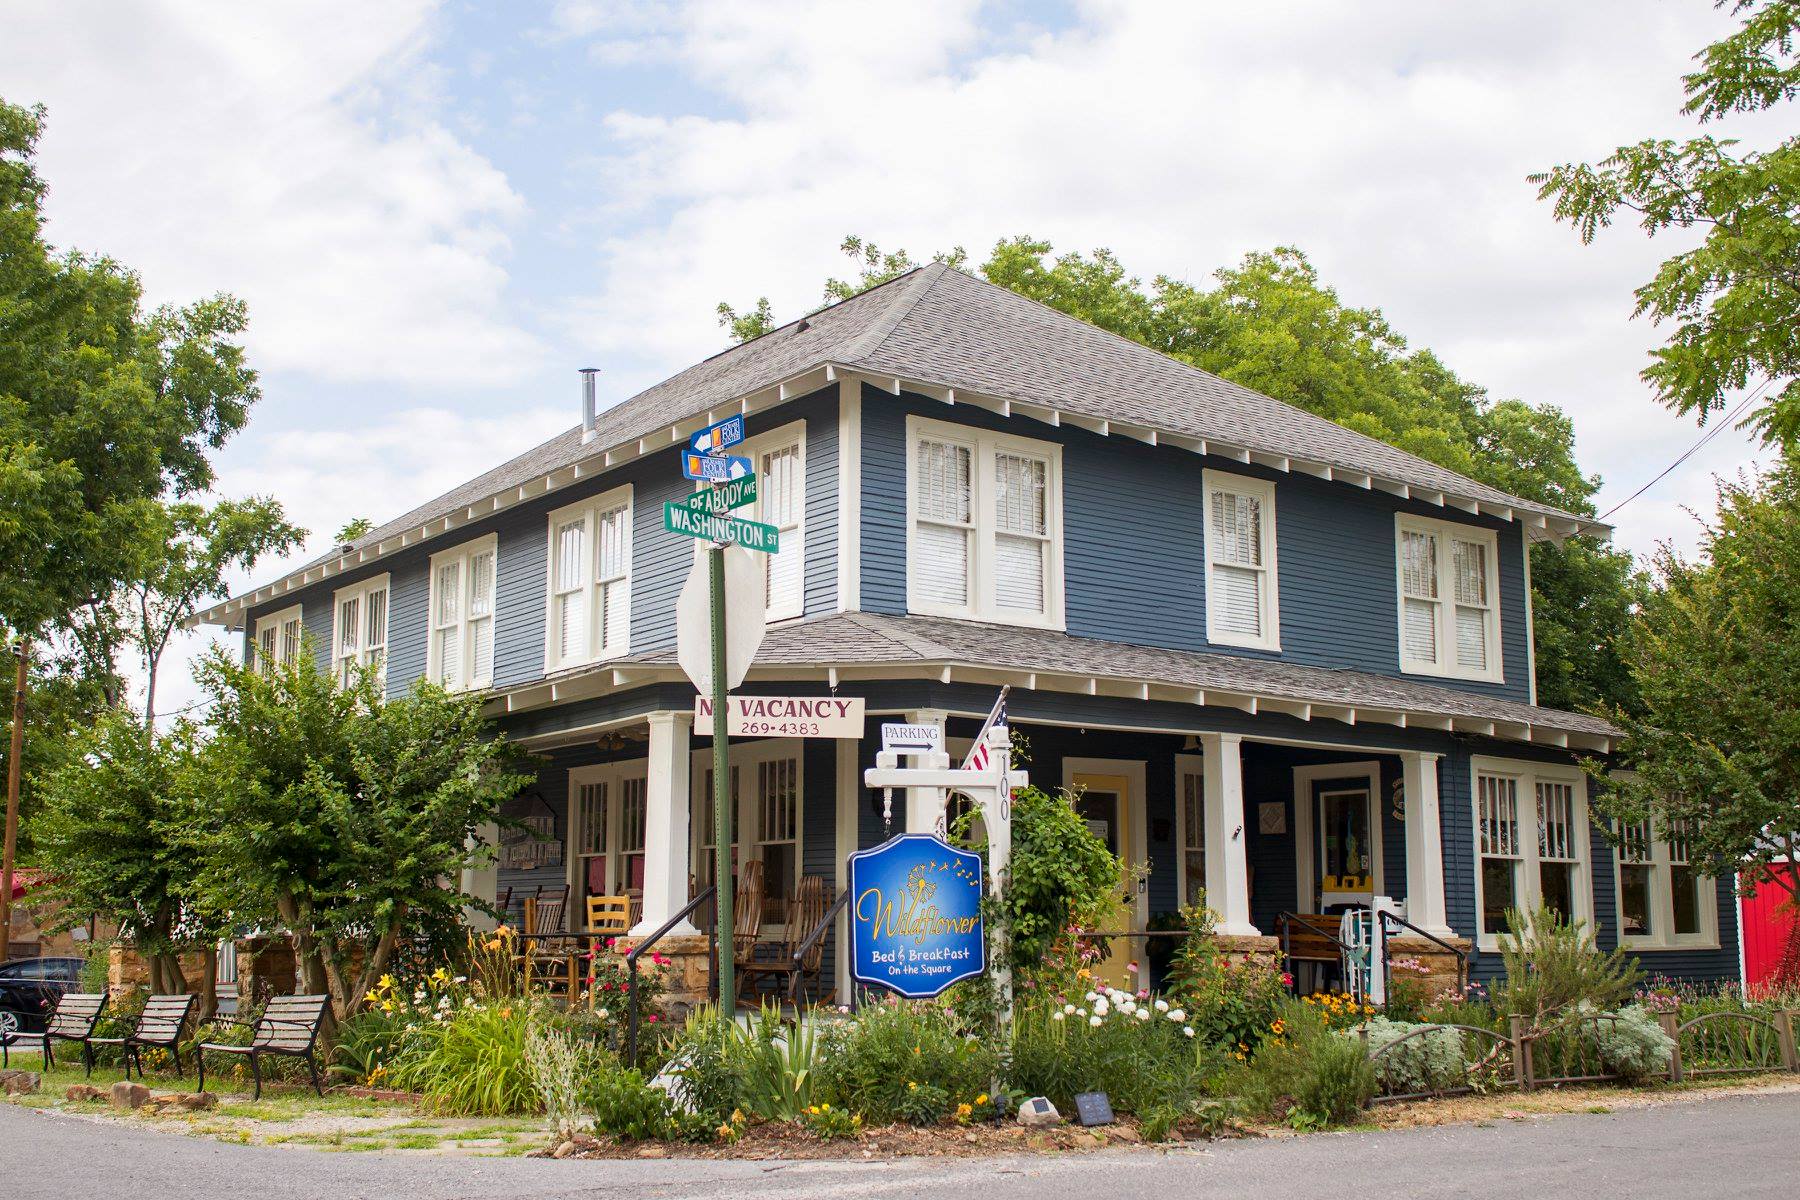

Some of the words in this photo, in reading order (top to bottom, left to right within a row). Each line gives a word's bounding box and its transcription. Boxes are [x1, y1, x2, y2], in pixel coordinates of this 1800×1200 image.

[744, 482, 756, 495] AVE
[670, 507, 763, 547] WASHINGTON
[767, 534, 777, 546] ST
[700, 698, 729, 716] N
[739, 699, 852, 718] VACANCY
[741, 722, 819, 735] 269-4383
[885, 726, 938, 739] PARKING
[857, 887, 979, 945] Wildflower
[872, 950, 896, 963] Bed
[909, 947, 970, 962] Breakfast
[888, 965, 901, 975] On
[902, 964, 919, 975] the
[921, 963, 952, 977] Square
